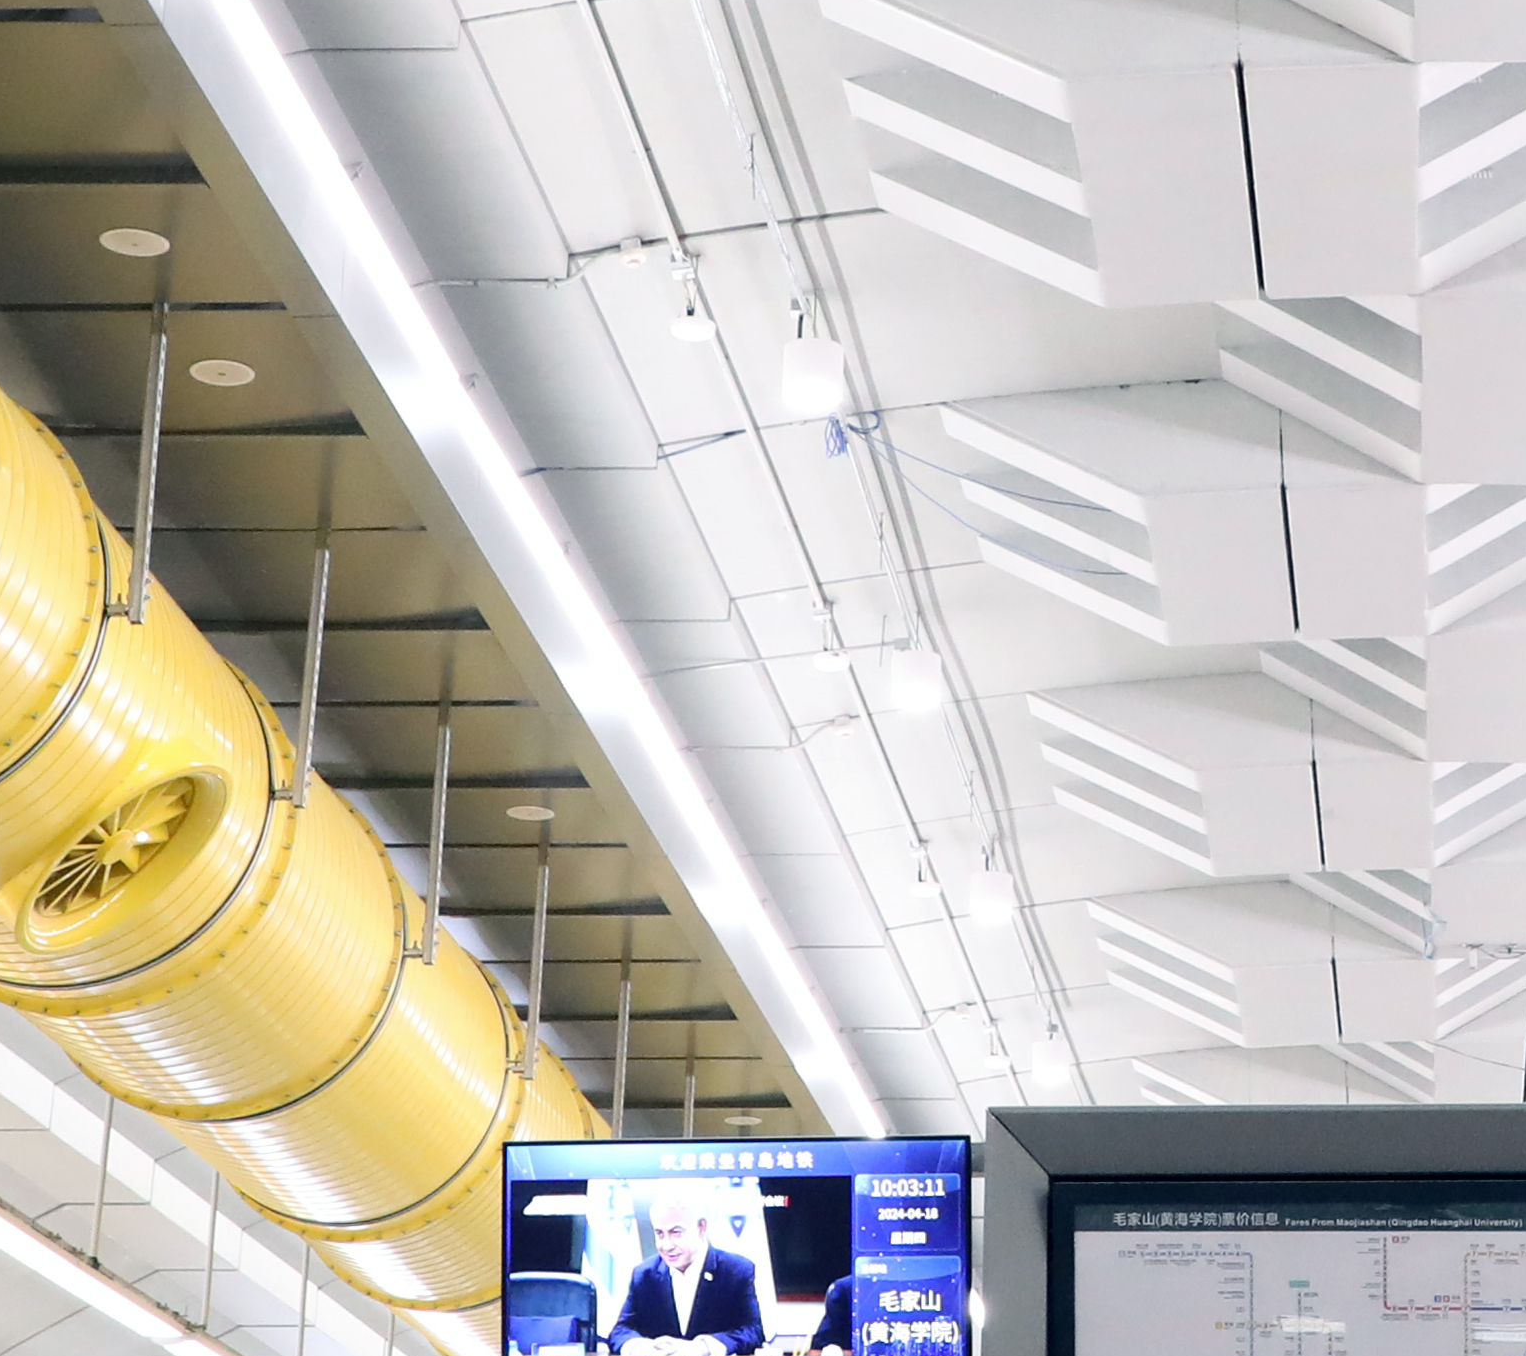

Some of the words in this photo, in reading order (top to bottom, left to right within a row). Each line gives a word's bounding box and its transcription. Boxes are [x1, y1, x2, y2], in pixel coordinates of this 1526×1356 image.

[659, 1151, 814, 1170] 欢迎乘坐青岛地铁
[871, 1178, 946, 1197] 10:03:11
[878, 1207, 939, 1220] 2024-04-18
[1285, 1218, 1309, 1226] Fares
[1312, 1218, 1335, 1226] From
[1336, 1218, 1386, 1227] Maojiashan
[1388, 1218, 1429, 1227] (Qingdao
[1431, 1218, 1473, 1227] Huanghai
[1474, 1218, 1523, 1227] University)
[879, 1290, 942, 1312] 毛家山
[861, 1321, 959, 1346] (黄海学院)
